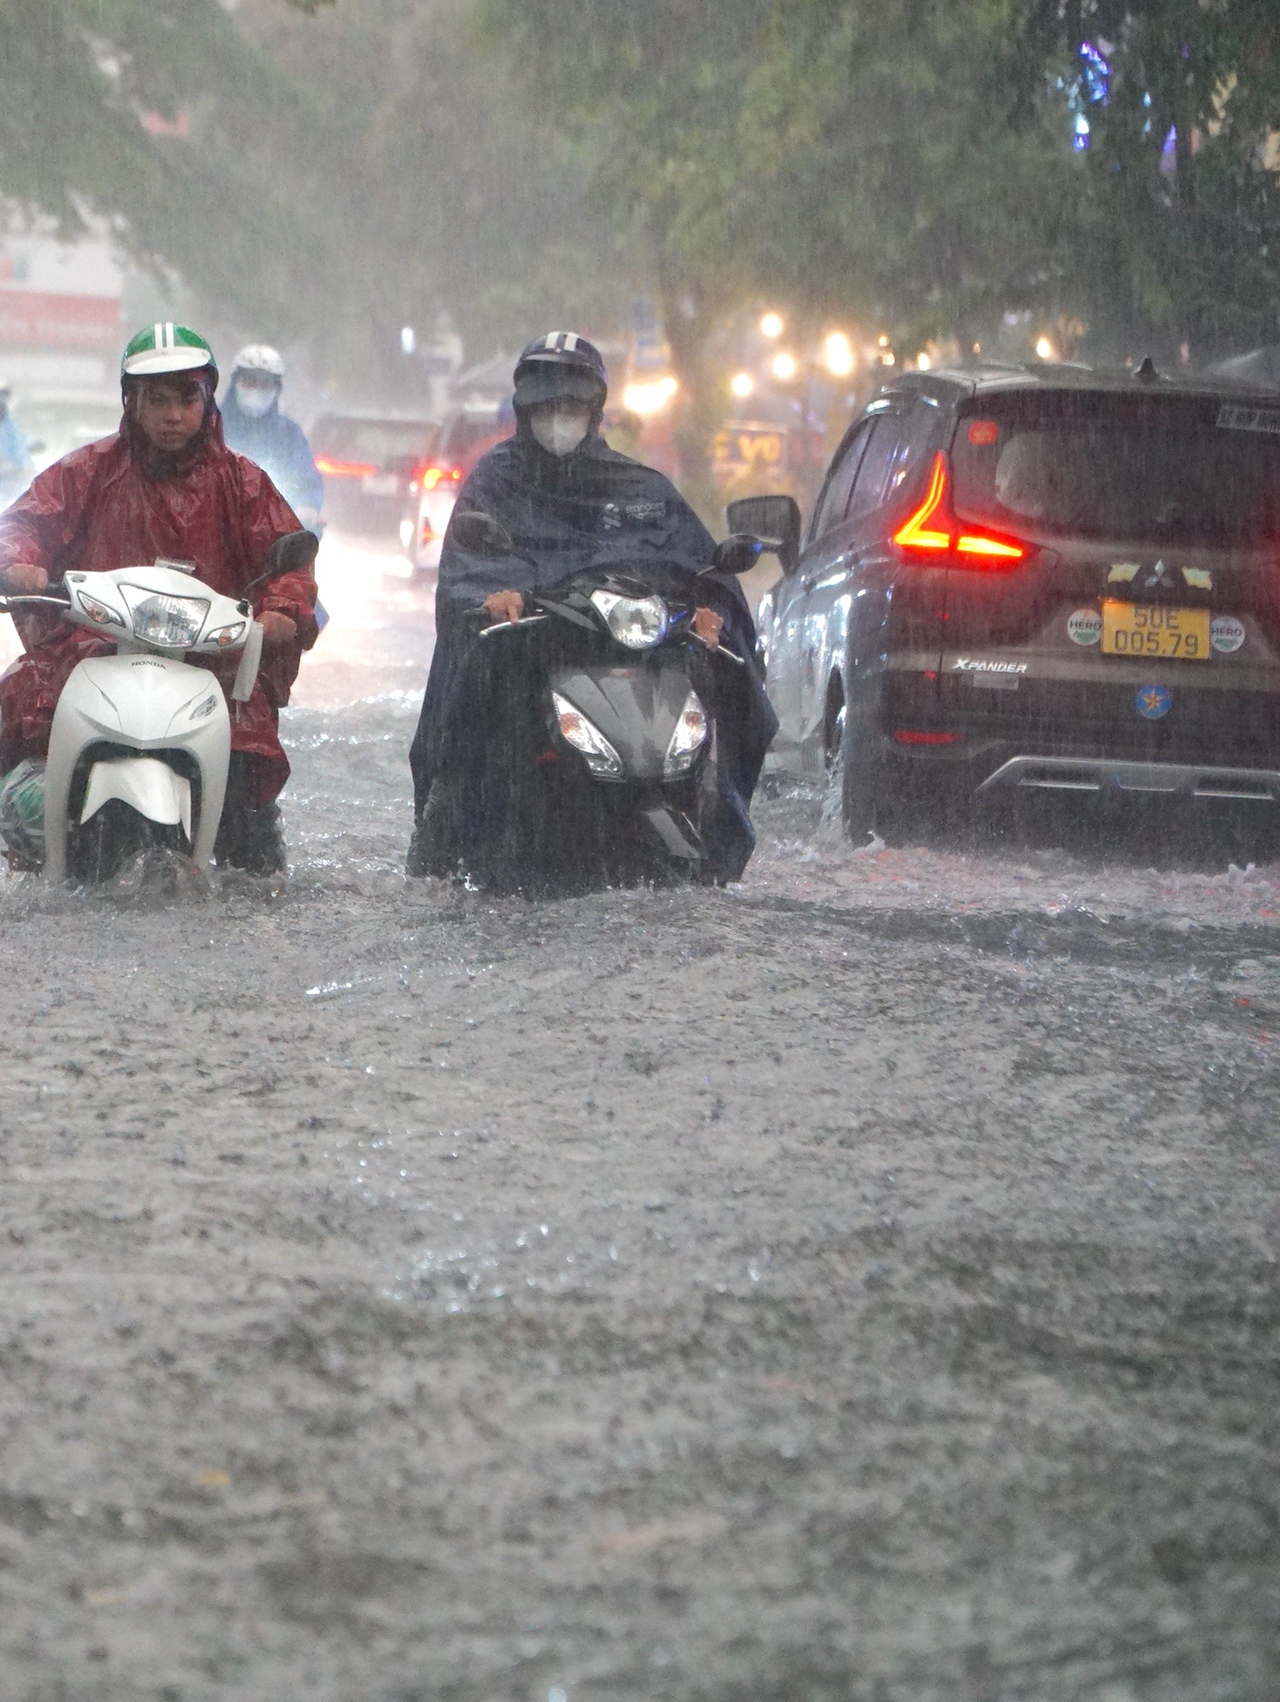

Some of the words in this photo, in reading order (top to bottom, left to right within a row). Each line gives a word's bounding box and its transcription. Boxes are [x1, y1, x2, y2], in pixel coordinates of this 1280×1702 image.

[1134, 605, 1179, 630] 50E
[1070, 620, 1102, 631] HERO
[1211, 626, 1243, 637] HERO
[1114, 629, 1199, 657] 005.79
[131, 660, 167, 671] HONDA
[950, 657, 1028, 674] XPANDER
